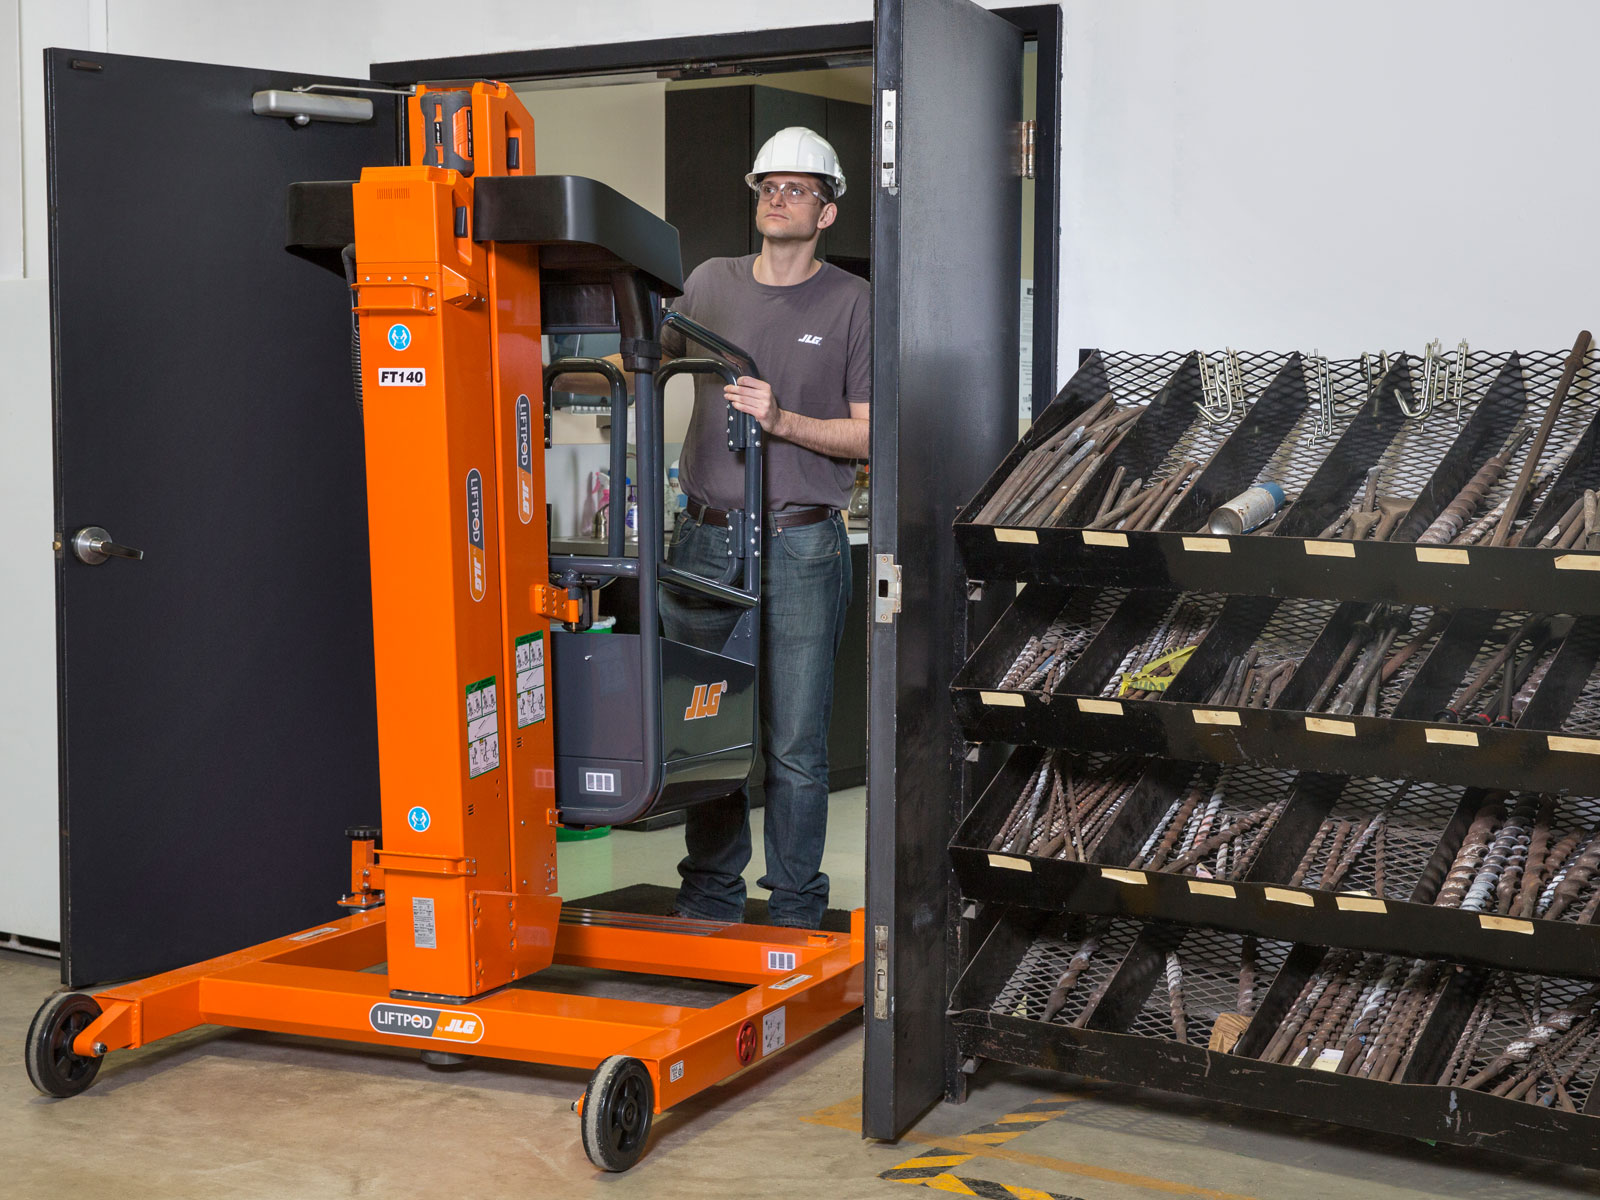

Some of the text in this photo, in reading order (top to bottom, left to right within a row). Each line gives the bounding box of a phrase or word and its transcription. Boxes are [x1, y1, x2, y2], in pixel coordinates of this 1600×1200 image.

[798, 334, 823, 345] JLG
[381, 371, 423, 383] FT140
[519, 403, 528, 466] LIFTPOD
[470, 478, 480, 542] LIFTPOD
[522, 480, 530, 515] JLG
[473, 557, 482, 592] JLG
[377, 1010, 433, 1029] LIFTPOD
[444, 1018, 477, 1034] JLG
